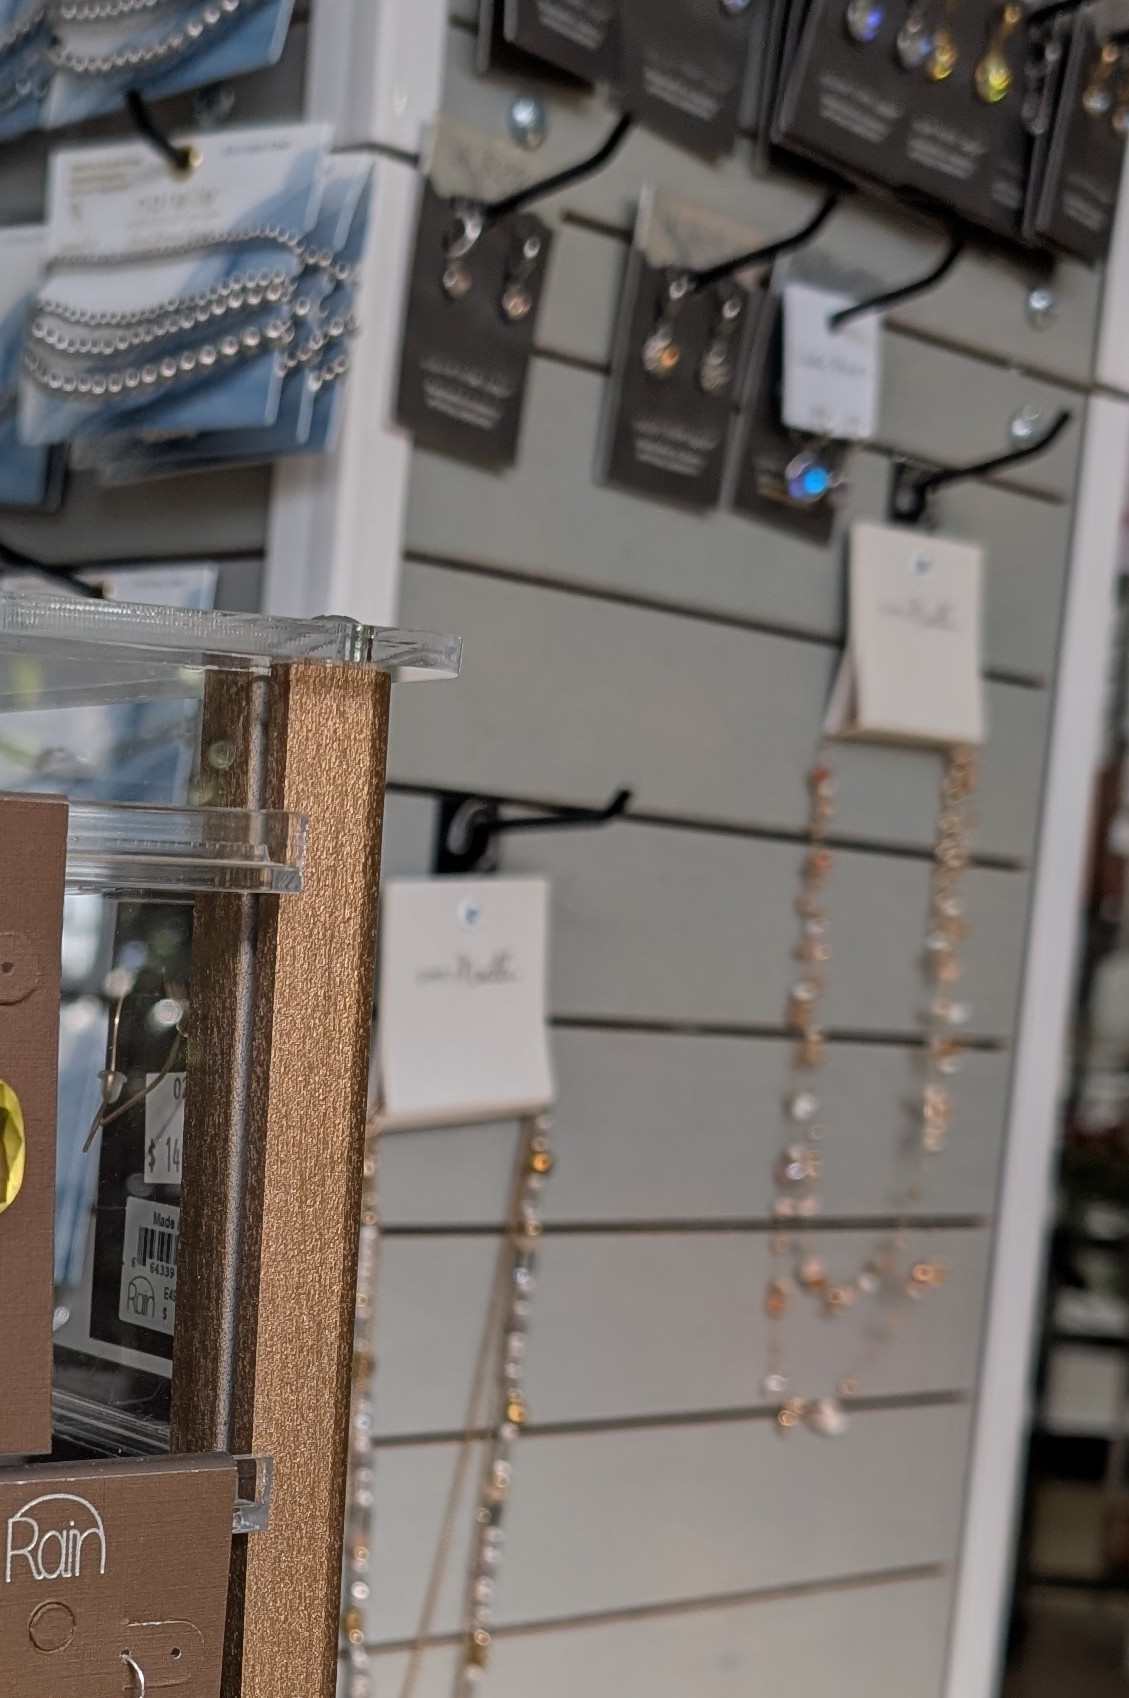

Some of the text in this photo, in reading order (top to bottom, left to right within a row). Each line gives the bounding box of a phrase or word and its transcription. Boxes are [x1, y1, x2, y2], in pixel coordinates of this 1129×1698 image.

[153, 1211, 175, 1229] Made
[150, 1262, 174, 1279] 64339
[127, 1275, 156, 1318] Rain
[5, 1493, 106, 1583] Rain
